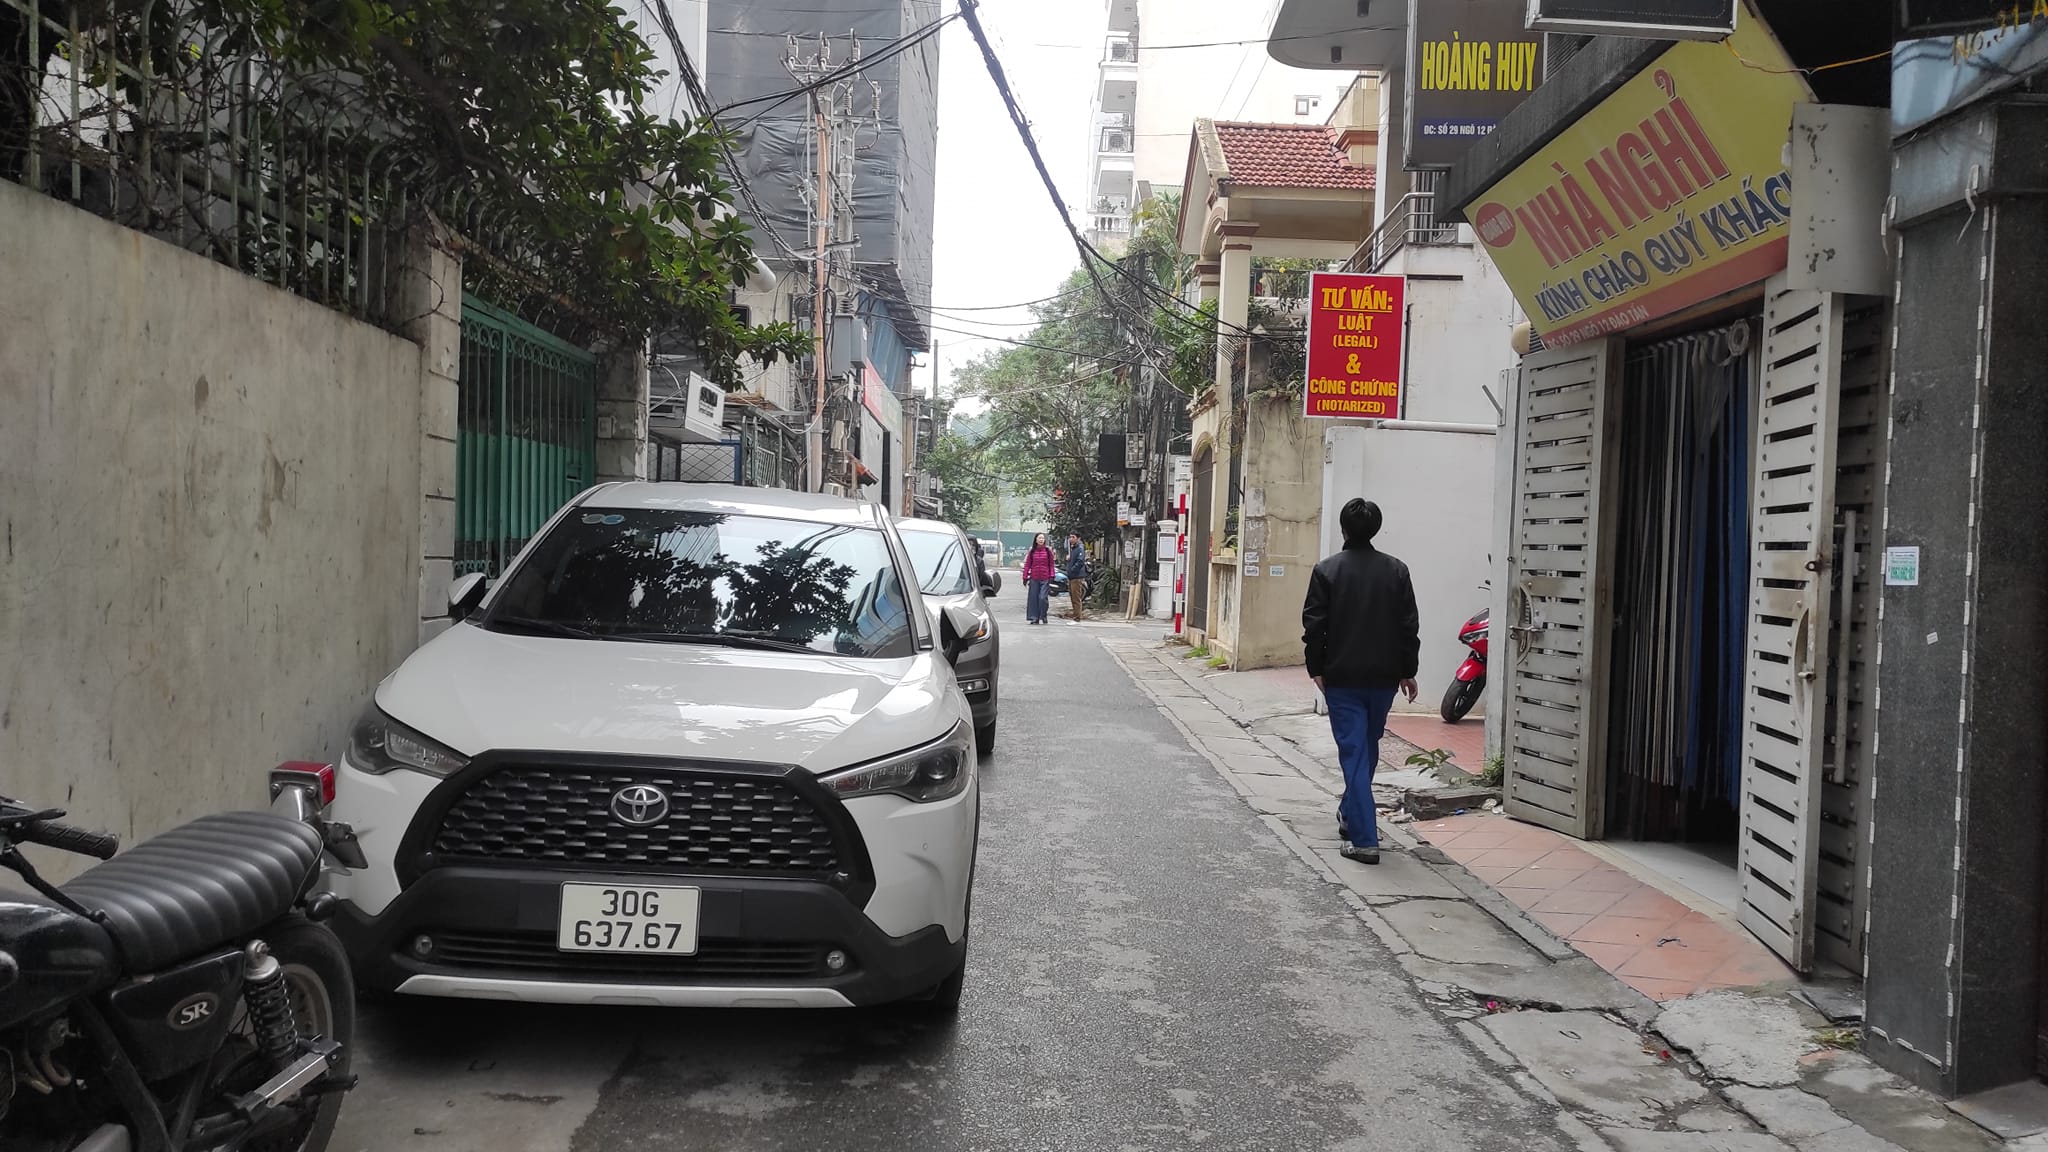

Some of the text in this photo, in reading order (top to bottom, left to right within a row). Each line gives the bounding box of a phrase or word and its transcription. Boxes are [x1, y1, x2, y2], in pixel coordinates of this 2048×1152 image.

[1422, 31, 1537, 91] HOÀNG HUY
[1449, 124, 1459, 135] 29
[1477, 125, 1486, 135] 12
[1514, 68, 1731, 270] NHÀ NGHỈ
[1534, 169, 1792, 322] KÍNH CHÀO QUÝ KHÁC
[1321, 284, 1393, 311] TƯ VẤN:
[1338, 313, 1374, 333] LUẬT
[1333, 334, 1378, 349] (LEGAL)
[1346, 353, 1361, 374] &
[1309, 377, 1398, 397] CÔNG CHỨNG
[1317, 399, 1386, 415] (NOTARIZED)
[601, 889, 660, 917] 30G
[574, 920, 682, 949] 637.67
[181, 1001, 211, 1025] SR
